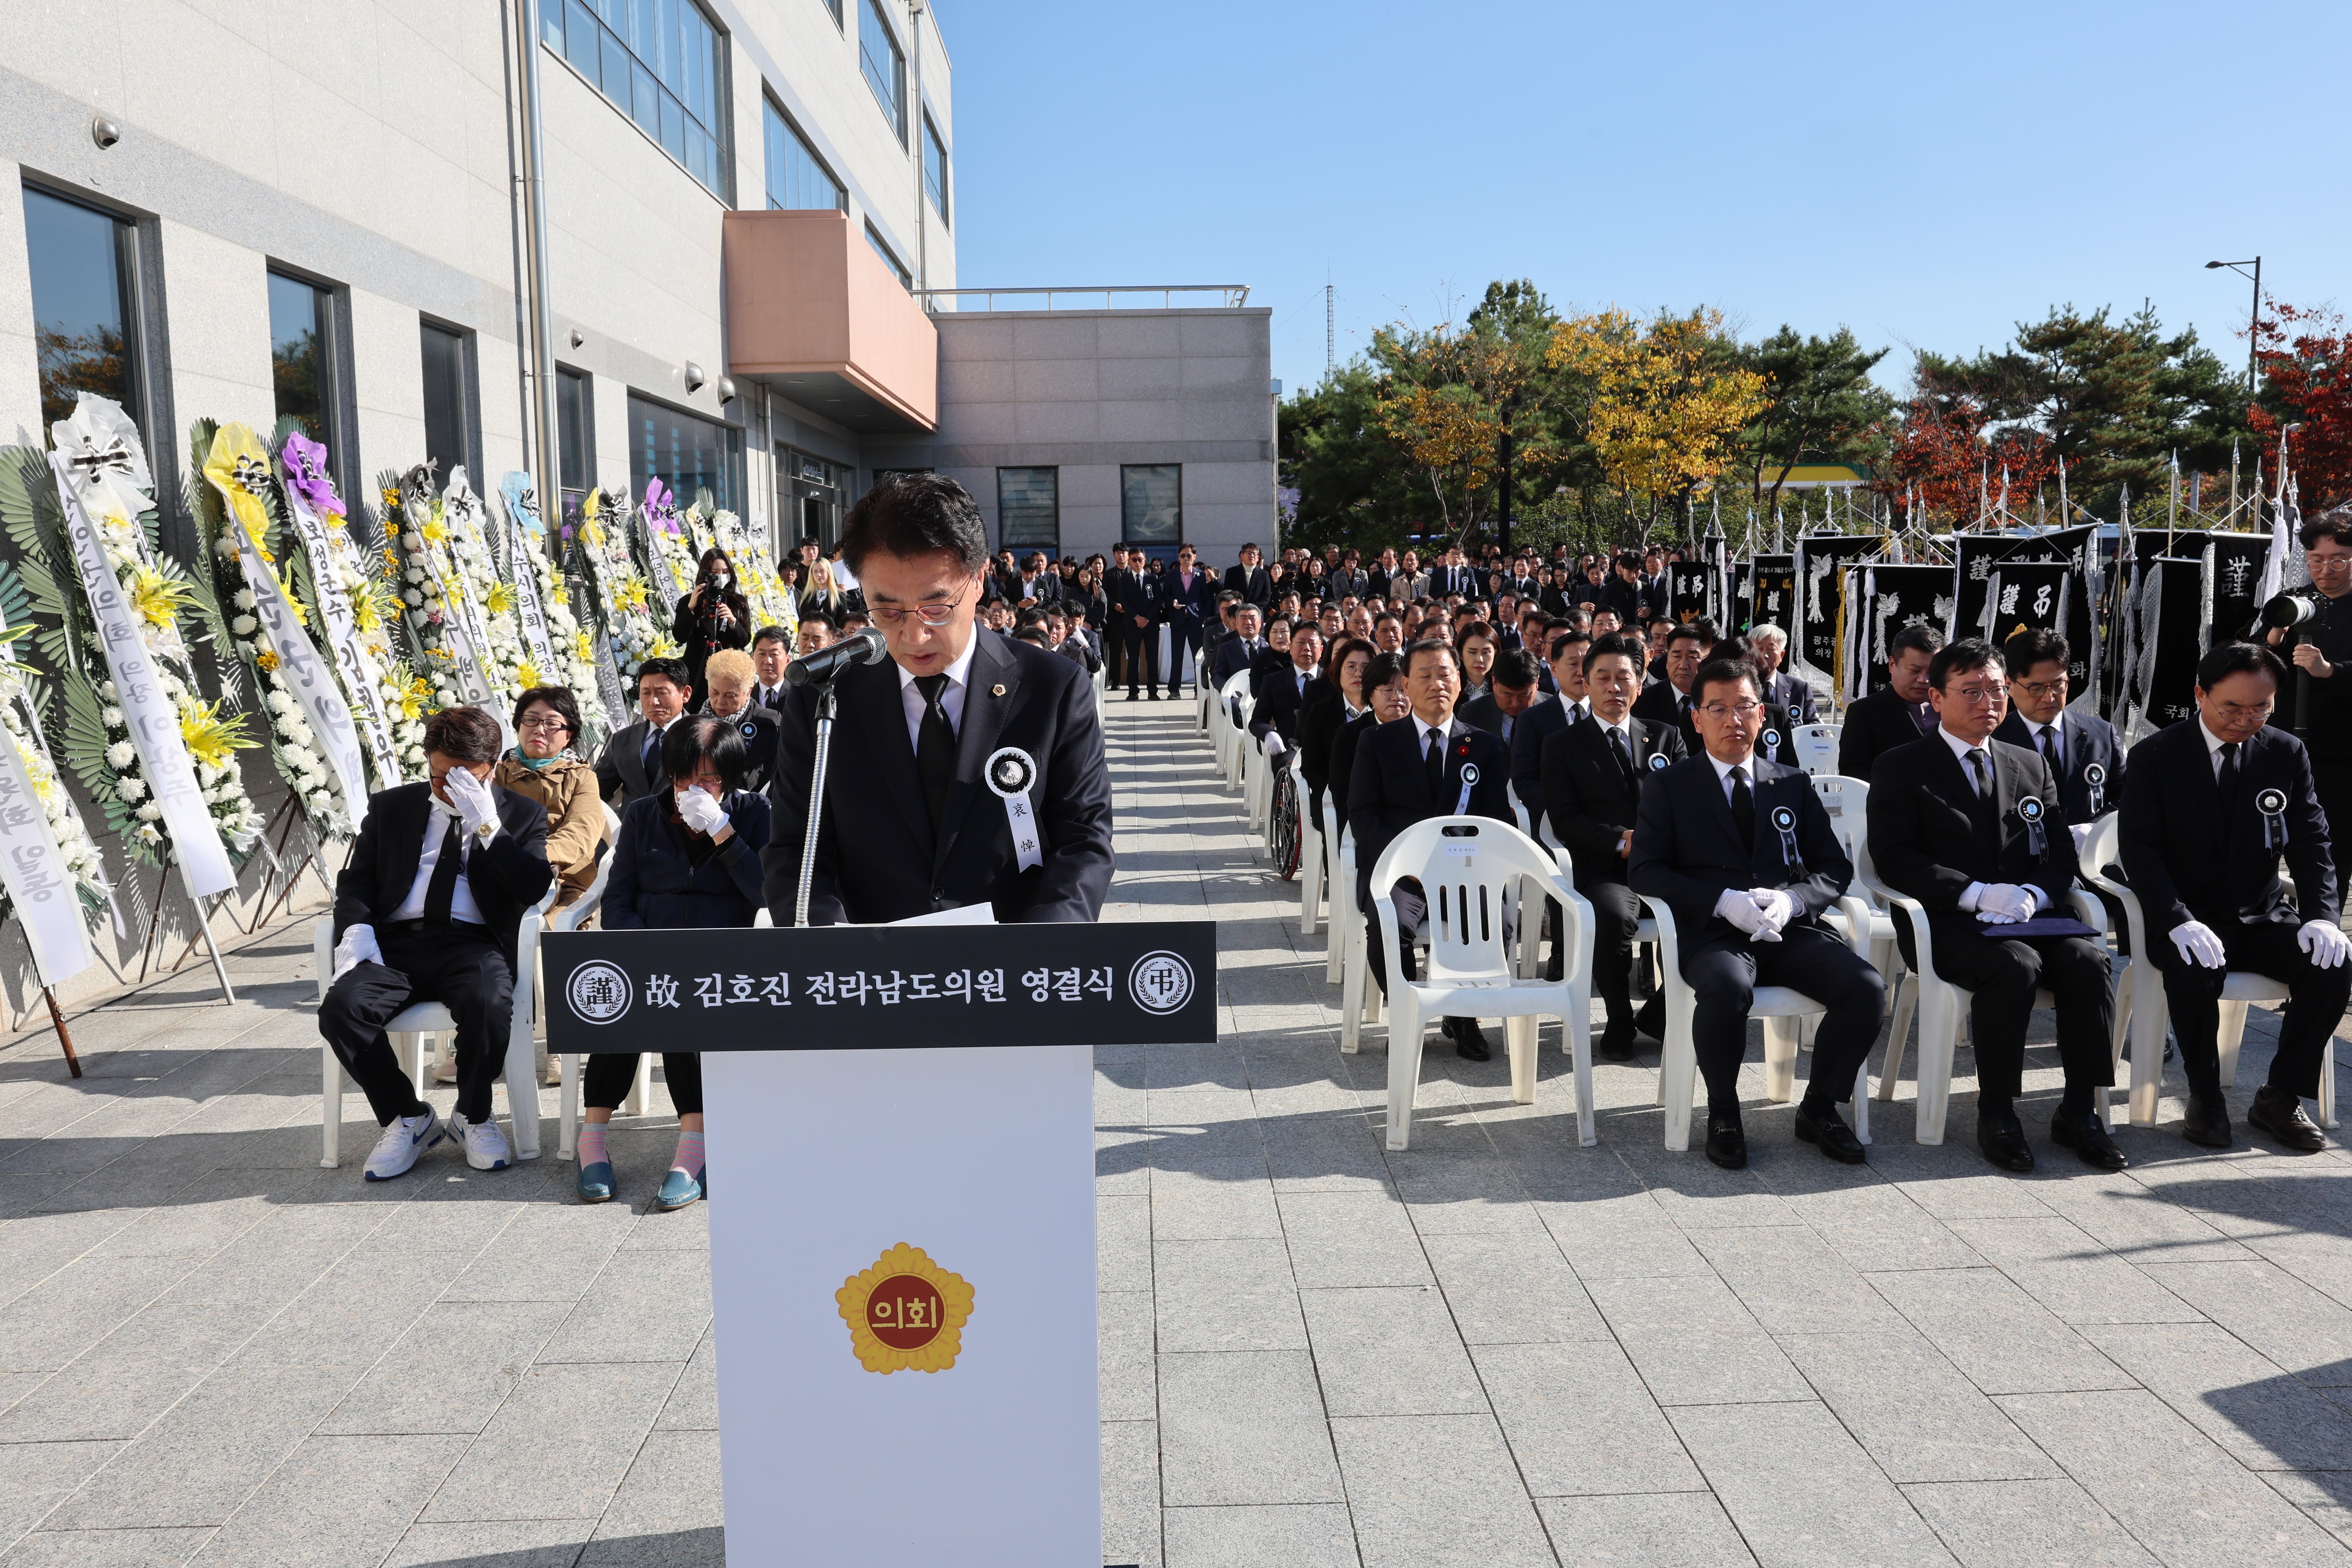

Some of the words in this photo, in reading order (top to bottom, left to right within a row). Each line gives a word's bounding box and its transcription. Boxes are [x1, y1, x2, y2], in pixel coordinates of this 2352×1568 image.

[2221, 555, 2251, 598] 謹
[511, 537, 541, 630] 여수시의회
[533, 641, 554, 673] 의장
[303, 521, 348, 623] 보성군수
[340, 639, 393, 777] 김철우
[1815, 648, 1832, 658] 의장
[1013, 803, 1035, 853] 哀悼
[2034, 826, 2047, 850] 哀悼
[2271, 820, 2281, 844] 哀悼
[1787, 837, 1795, 862] 哀悼
[584, 976, 613, 1005] 謹
[645, 974, 681, 1008] 故
[693, 972, 792, 1008] 김호진
[805, 968, 1007, 1006] 전라남도의원
[1022, 967, 1112, 1002] 영결식
[1150, 967, 1174, 996] 弔
[871, 1296, 937, 1329] 의회
